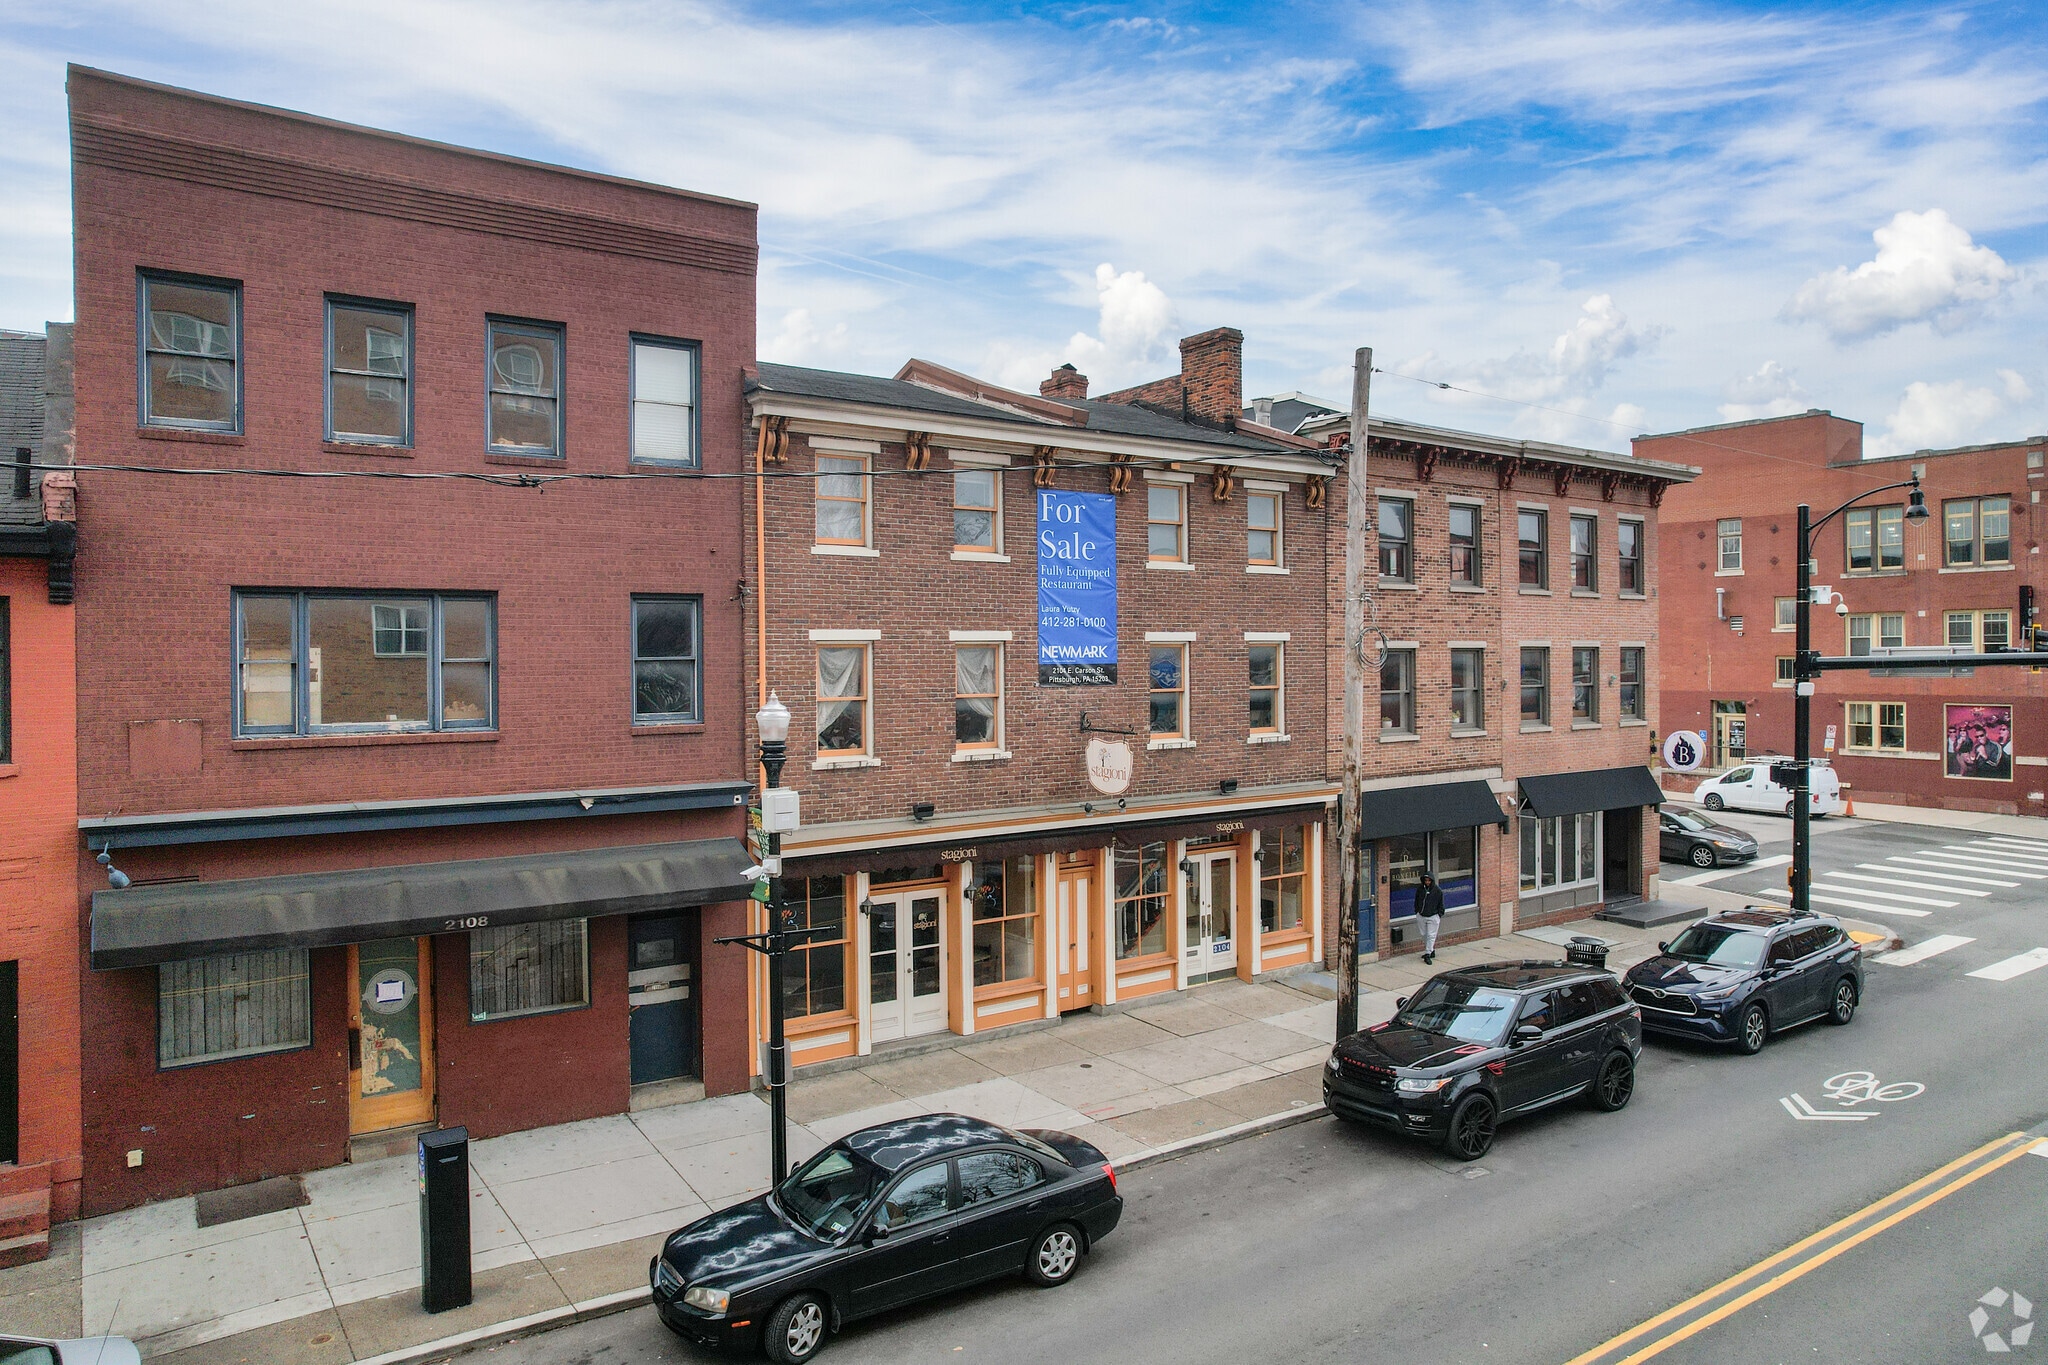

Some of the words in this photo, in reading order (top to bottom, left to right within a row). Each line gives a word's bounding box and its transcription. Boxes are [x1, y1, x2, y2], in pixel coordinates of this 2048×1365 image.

[1040, 492, 1086, 524] For
[1040, 529, 1096, 561] Sale
[1041, 564, 1064, 579] Fully
[1066, 565, 1110, 580] Equipped
[1041, 577, 1093, 590] Restaurant
[1041, 604, 1060, 613] Laura
[1041, 616, 1106, 628] 412-281-0100
[1041, 645, 1108, 659] NEWMARK
[1048, 676, 1082, 684] Pittsburgh,
[1092, 675, 1109, 683] 15203
[1679, 746, 1690, 763] B
[1091, 766, 1127, 782] stagioni
[1216, 820, 1244, 833] stagioni
[941, 846, 977, 861] stagioni
[445, 916, 488, 931] 2108
[1343, 1056, 1366, 1068] RANGE
[1369, 1065, 1397, 1076] ROVER
